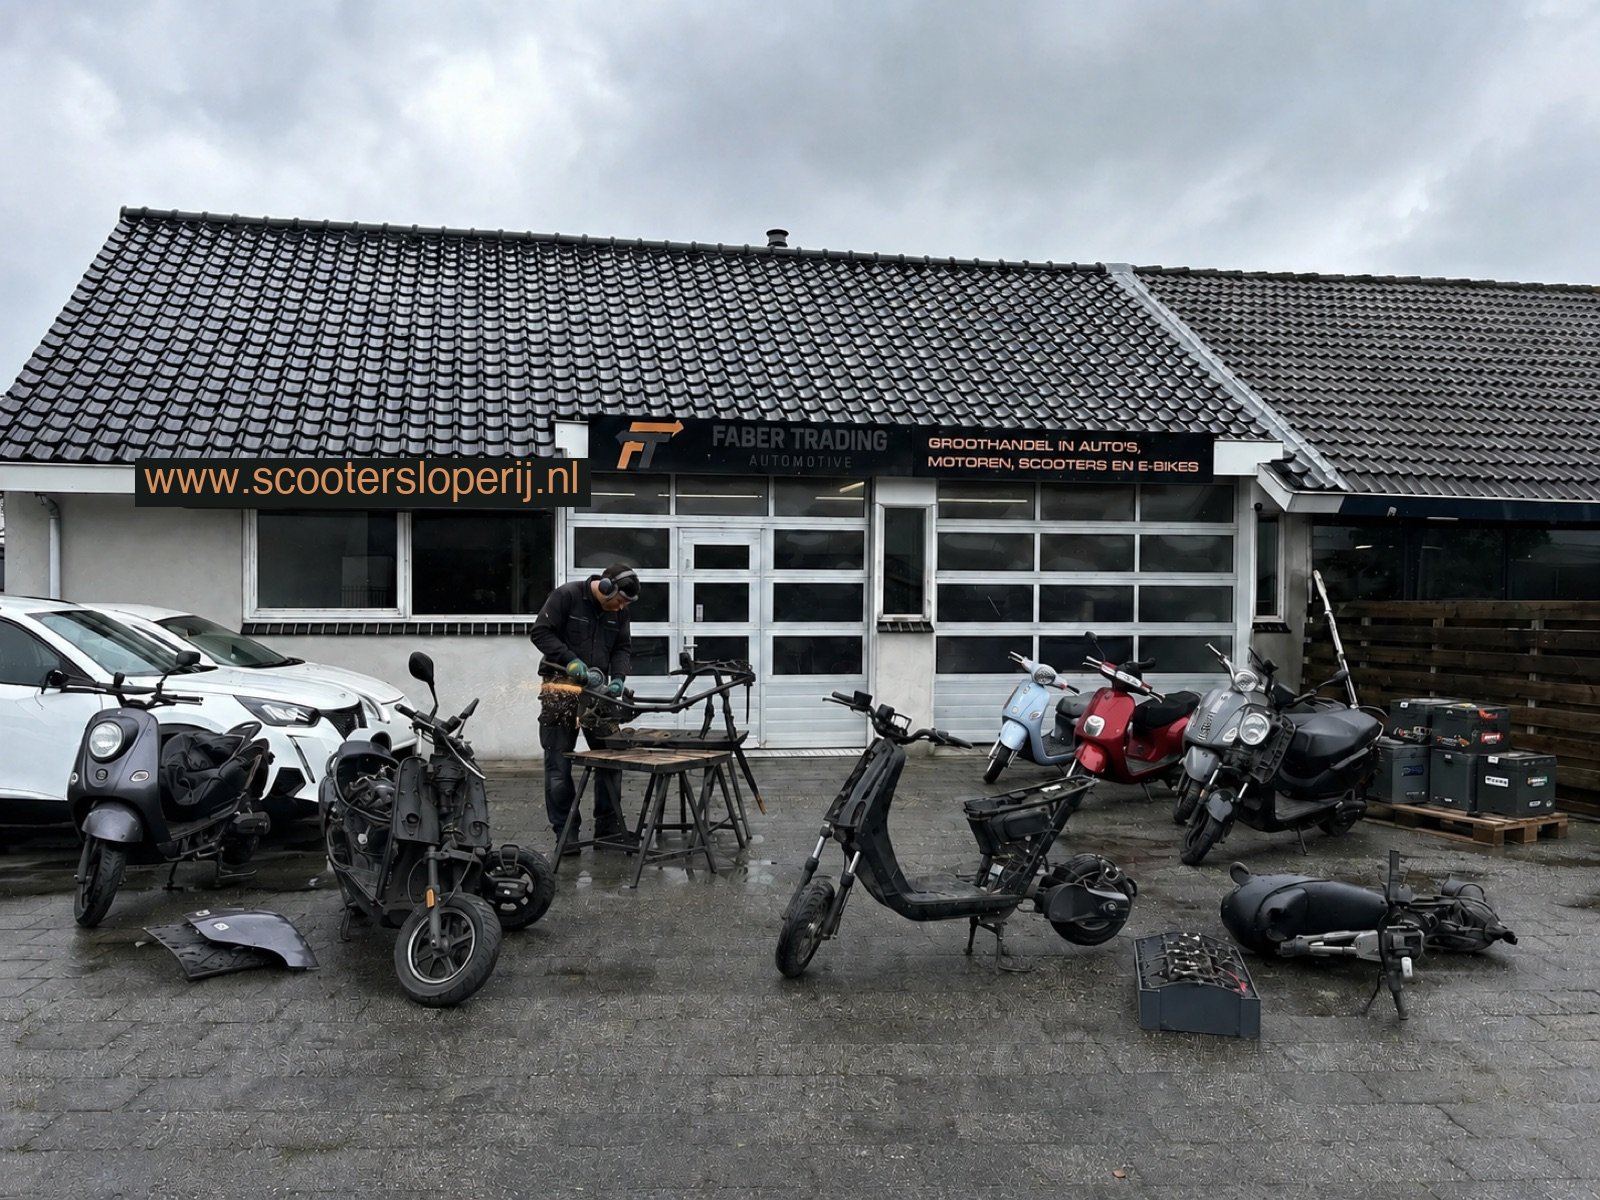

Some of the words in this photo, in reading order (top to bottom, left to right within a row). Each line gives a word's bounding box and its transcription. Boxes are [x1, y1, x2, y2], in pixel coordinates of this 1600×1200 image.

[712, 425, 785, 449] FABER
[790, 427, 888, 451] TRADING
[928, 437, 1054, 452] GROOTHANDEL
[1058, 440, 1075, 452] IN
[1078, 441, 1142, 454] AUTO'S,
[749, 454, 852, 468] AUTOMOTIVE
[927, 456, 1015, 471] MOTOREN,
[1018, 458, 1108, 471] SCOOTERS
[1112, 459, 1134, 472] EN
[1138, 460, 1200, 473] E-BIKES
